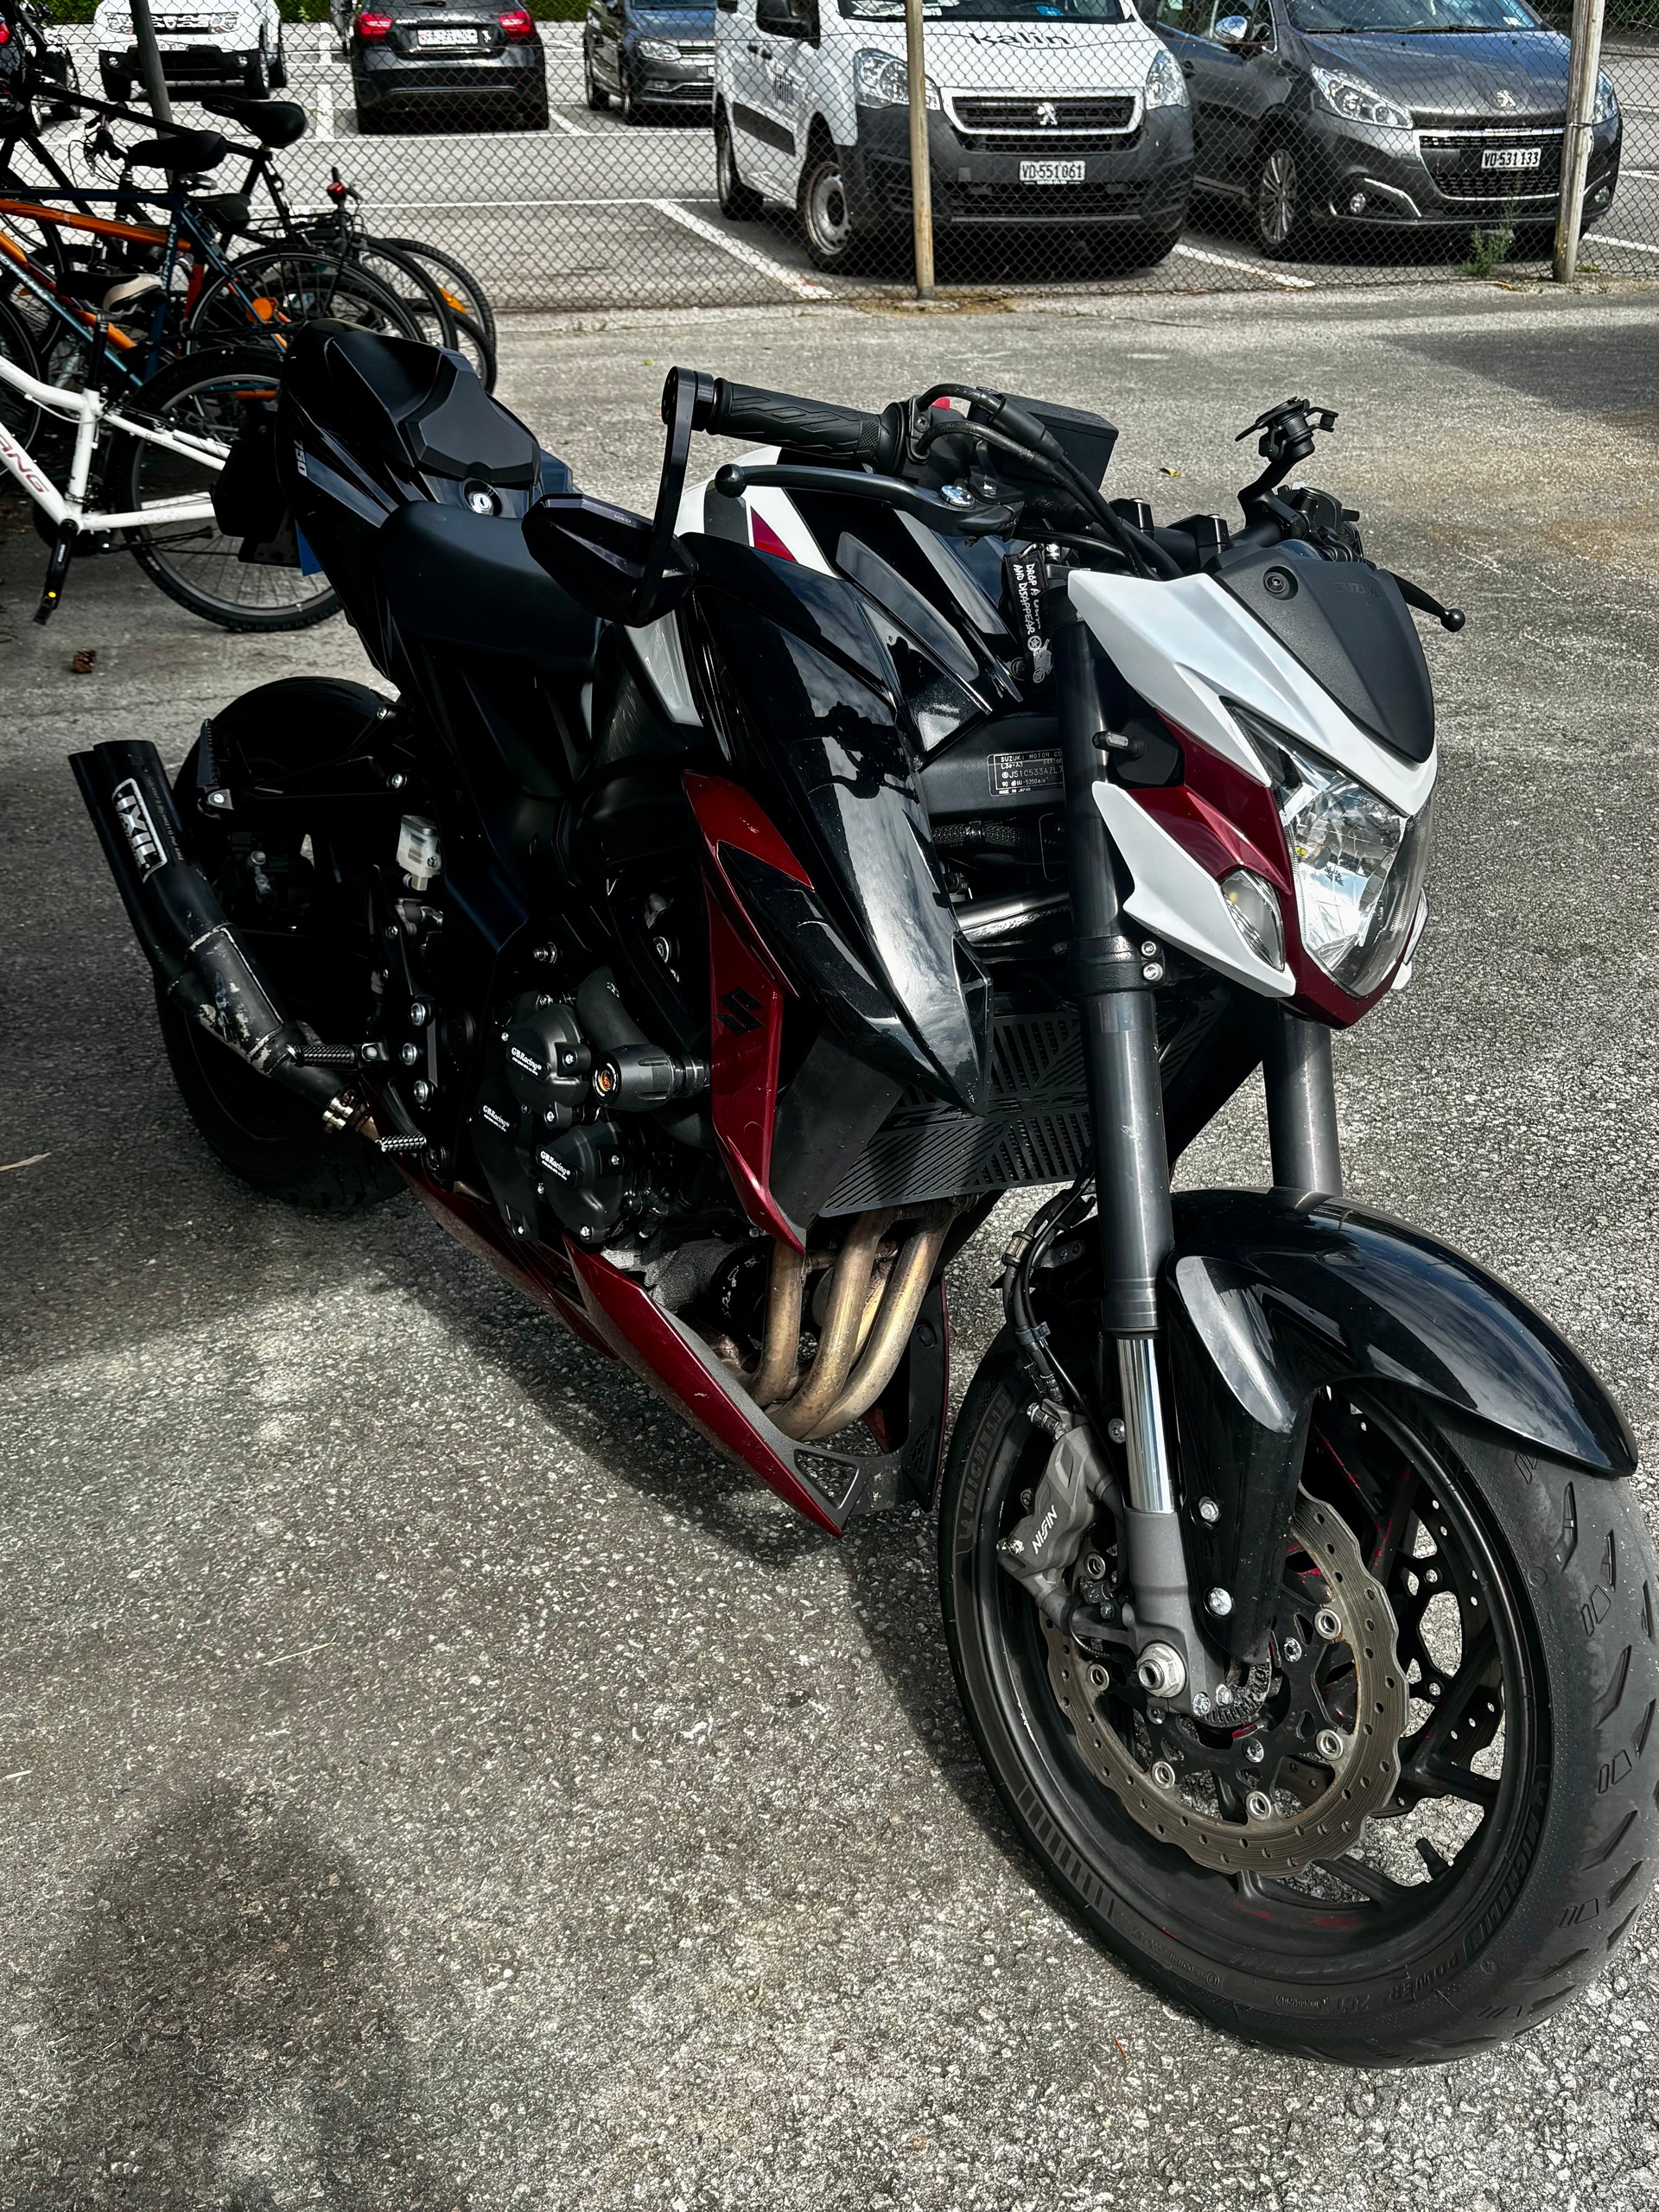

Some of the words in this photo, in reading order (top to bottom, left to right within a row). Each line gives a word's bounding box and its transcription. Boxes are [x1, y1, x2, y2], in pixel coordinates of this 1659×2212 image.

[969, 31, 1071, 45] kalin
[1014, 564, 1024, 581] AND
[1019, 582, 1035, 635] DISAPPEAR
[1027, 563, 1037, 588] DROP
[118, 795, 156, 865] IXIL
[963, 1394, 1010, 1512] MICHELIN
[1032, 1504, 1058, 1554] NISSIN
[1389, 1951, 1459, 2001] POWER
